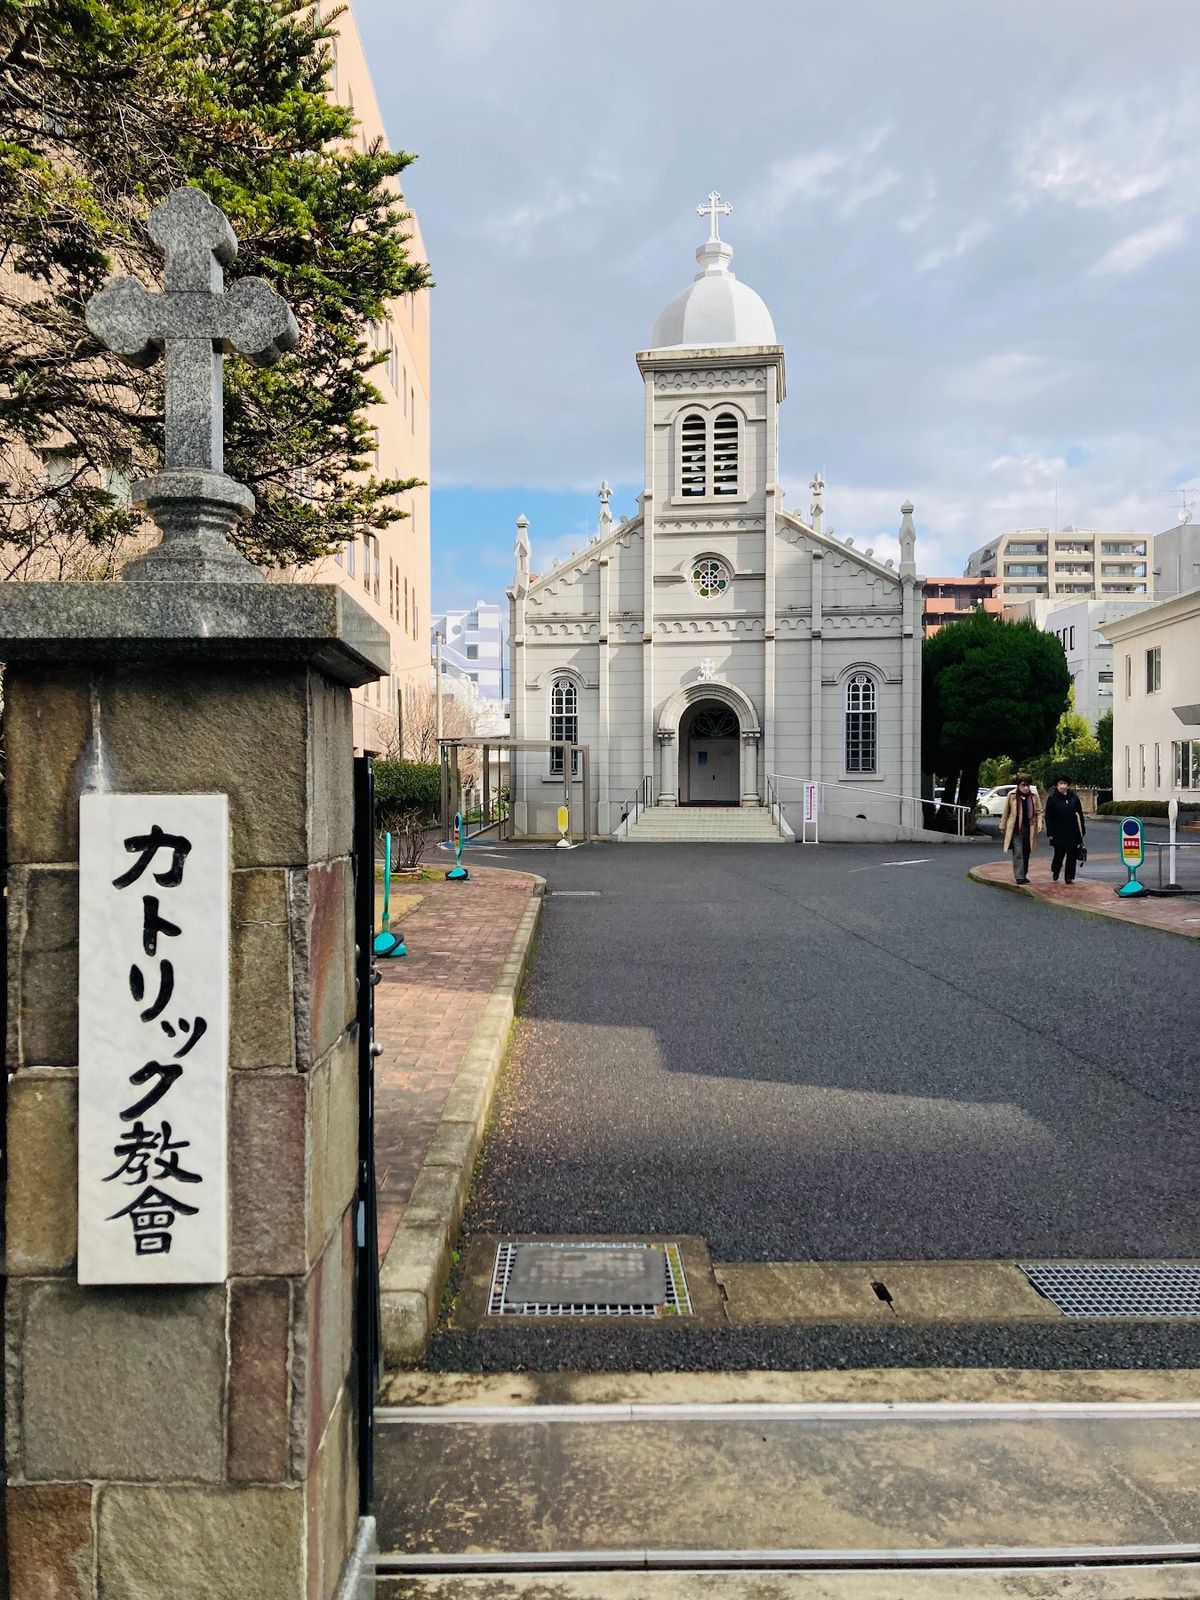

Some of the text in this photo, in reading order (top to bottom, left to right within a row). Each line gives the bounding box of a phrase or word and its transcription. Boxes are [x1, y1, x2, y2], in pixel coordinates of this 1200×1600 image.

[102, 824, 207, 1256] カトリック教會
